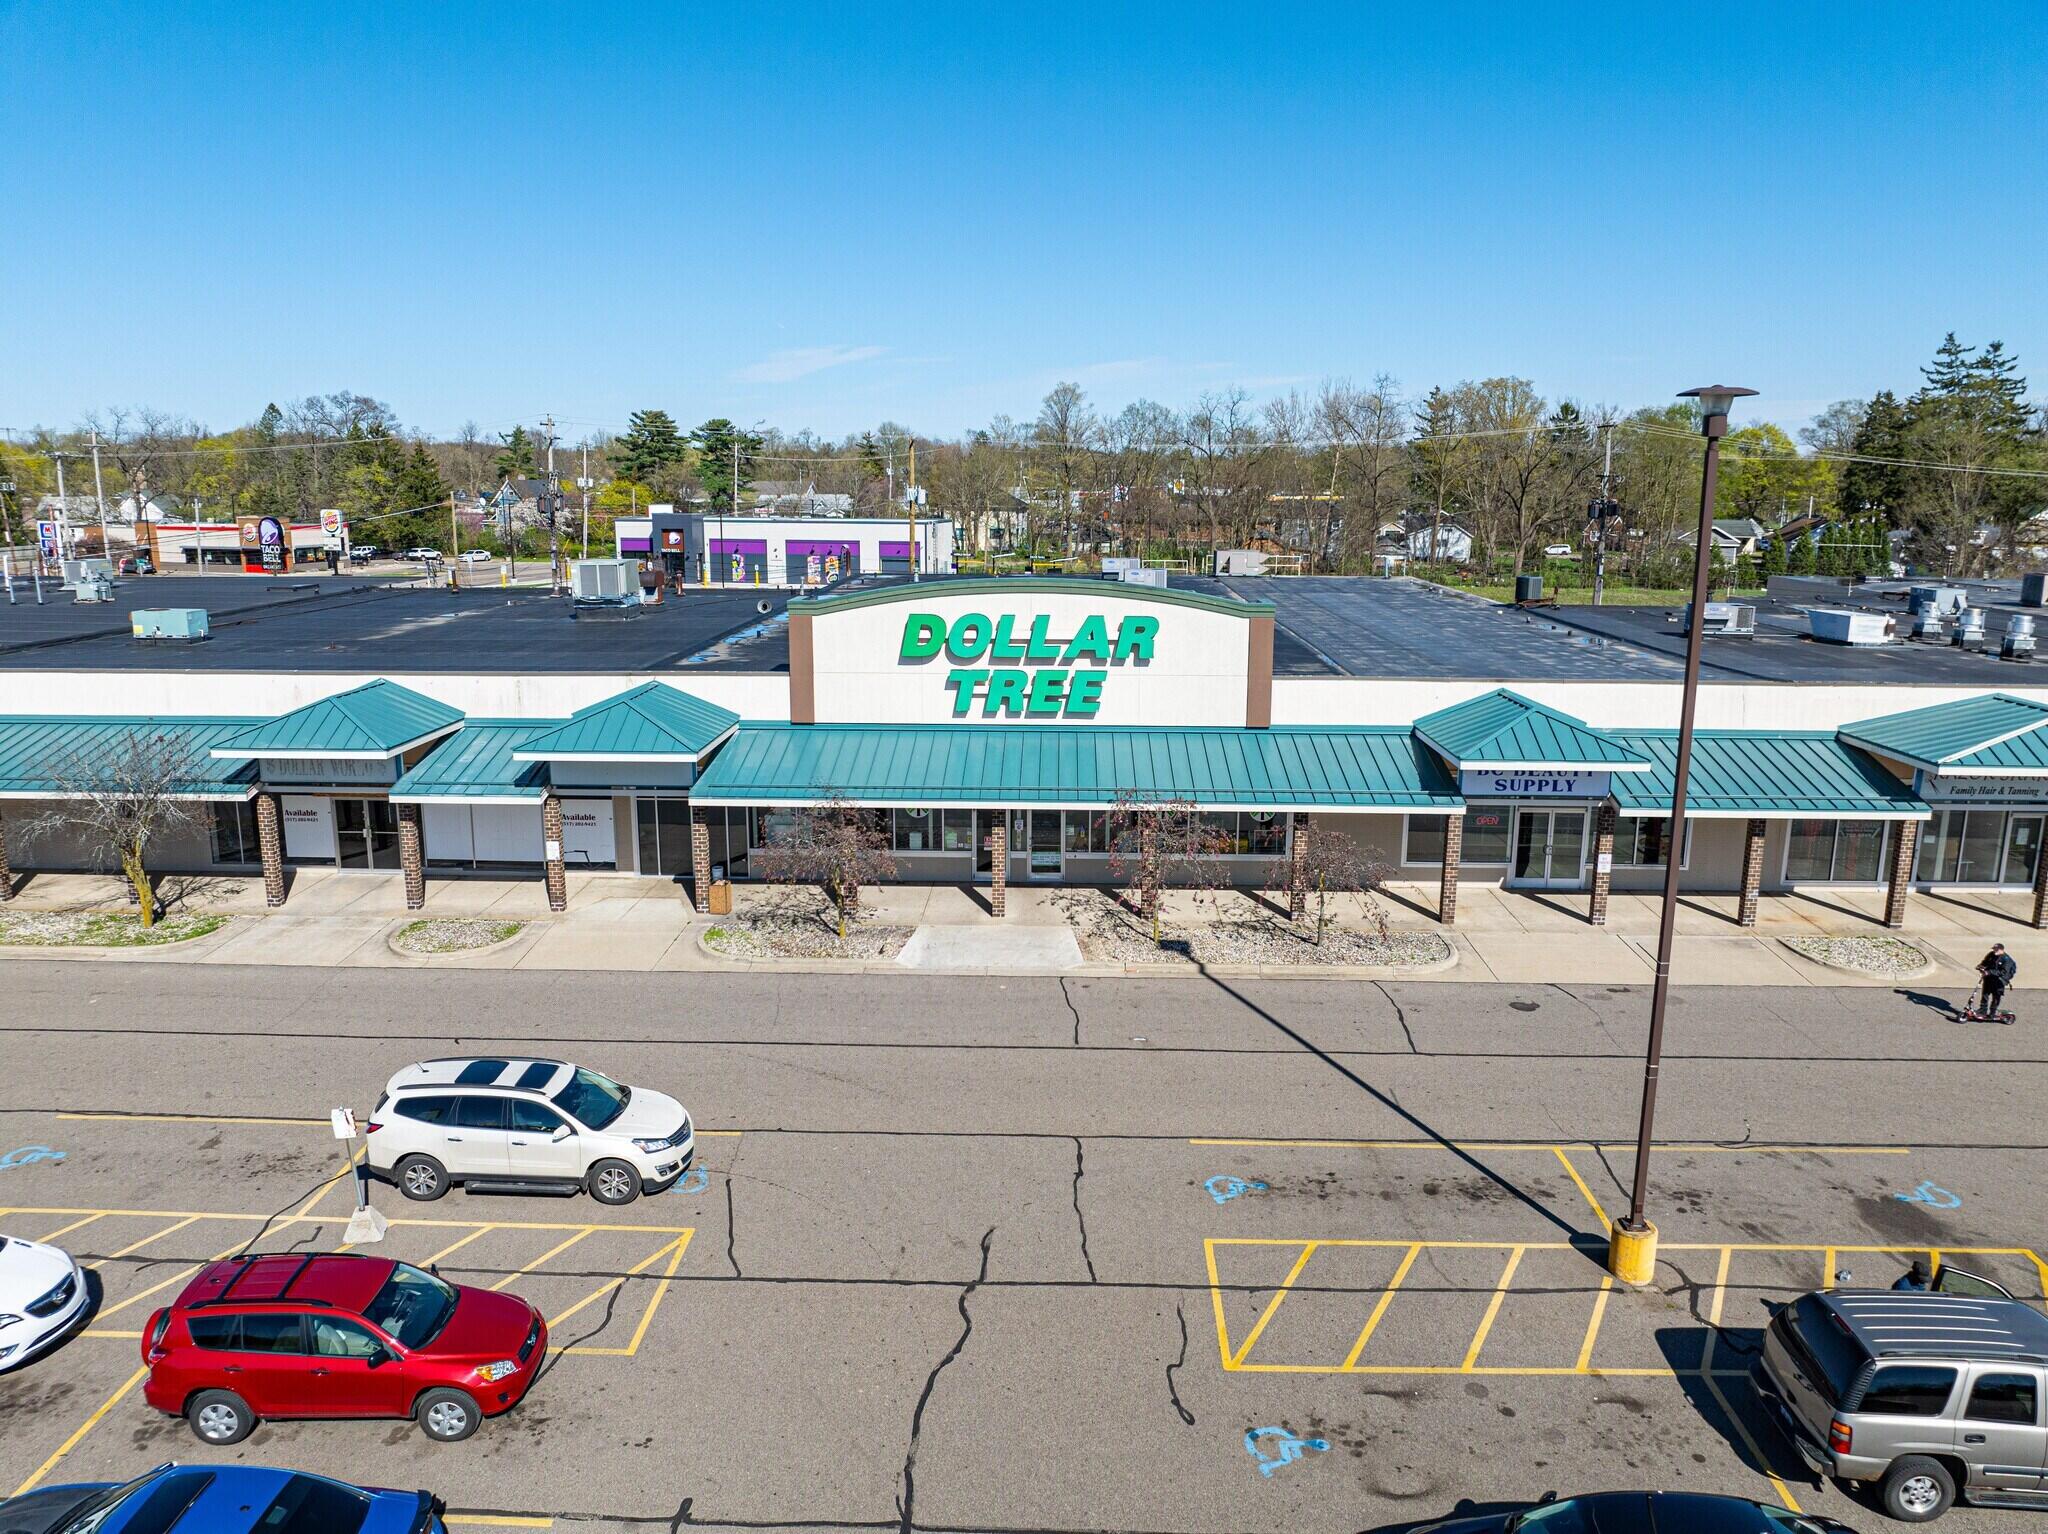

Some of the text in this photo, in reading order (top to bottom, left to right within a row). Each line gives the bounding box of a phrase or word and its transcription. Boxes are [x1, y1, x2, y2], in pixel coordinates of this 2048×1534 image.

[261, 545, 280, 553] TACO
[263, 554, 281, 562] BELL
[900, 613, 1159, 662] DOLLAR
[947, 669, 1108, 716] TREE
[280, 760, 324, 776] DOLLAR
[1494, 779, 1576, 792] SUPPLY
[1950, 786, 2040, 797] Family Hair & Tanning
[1476, 815, 1499, 825] OPEN
